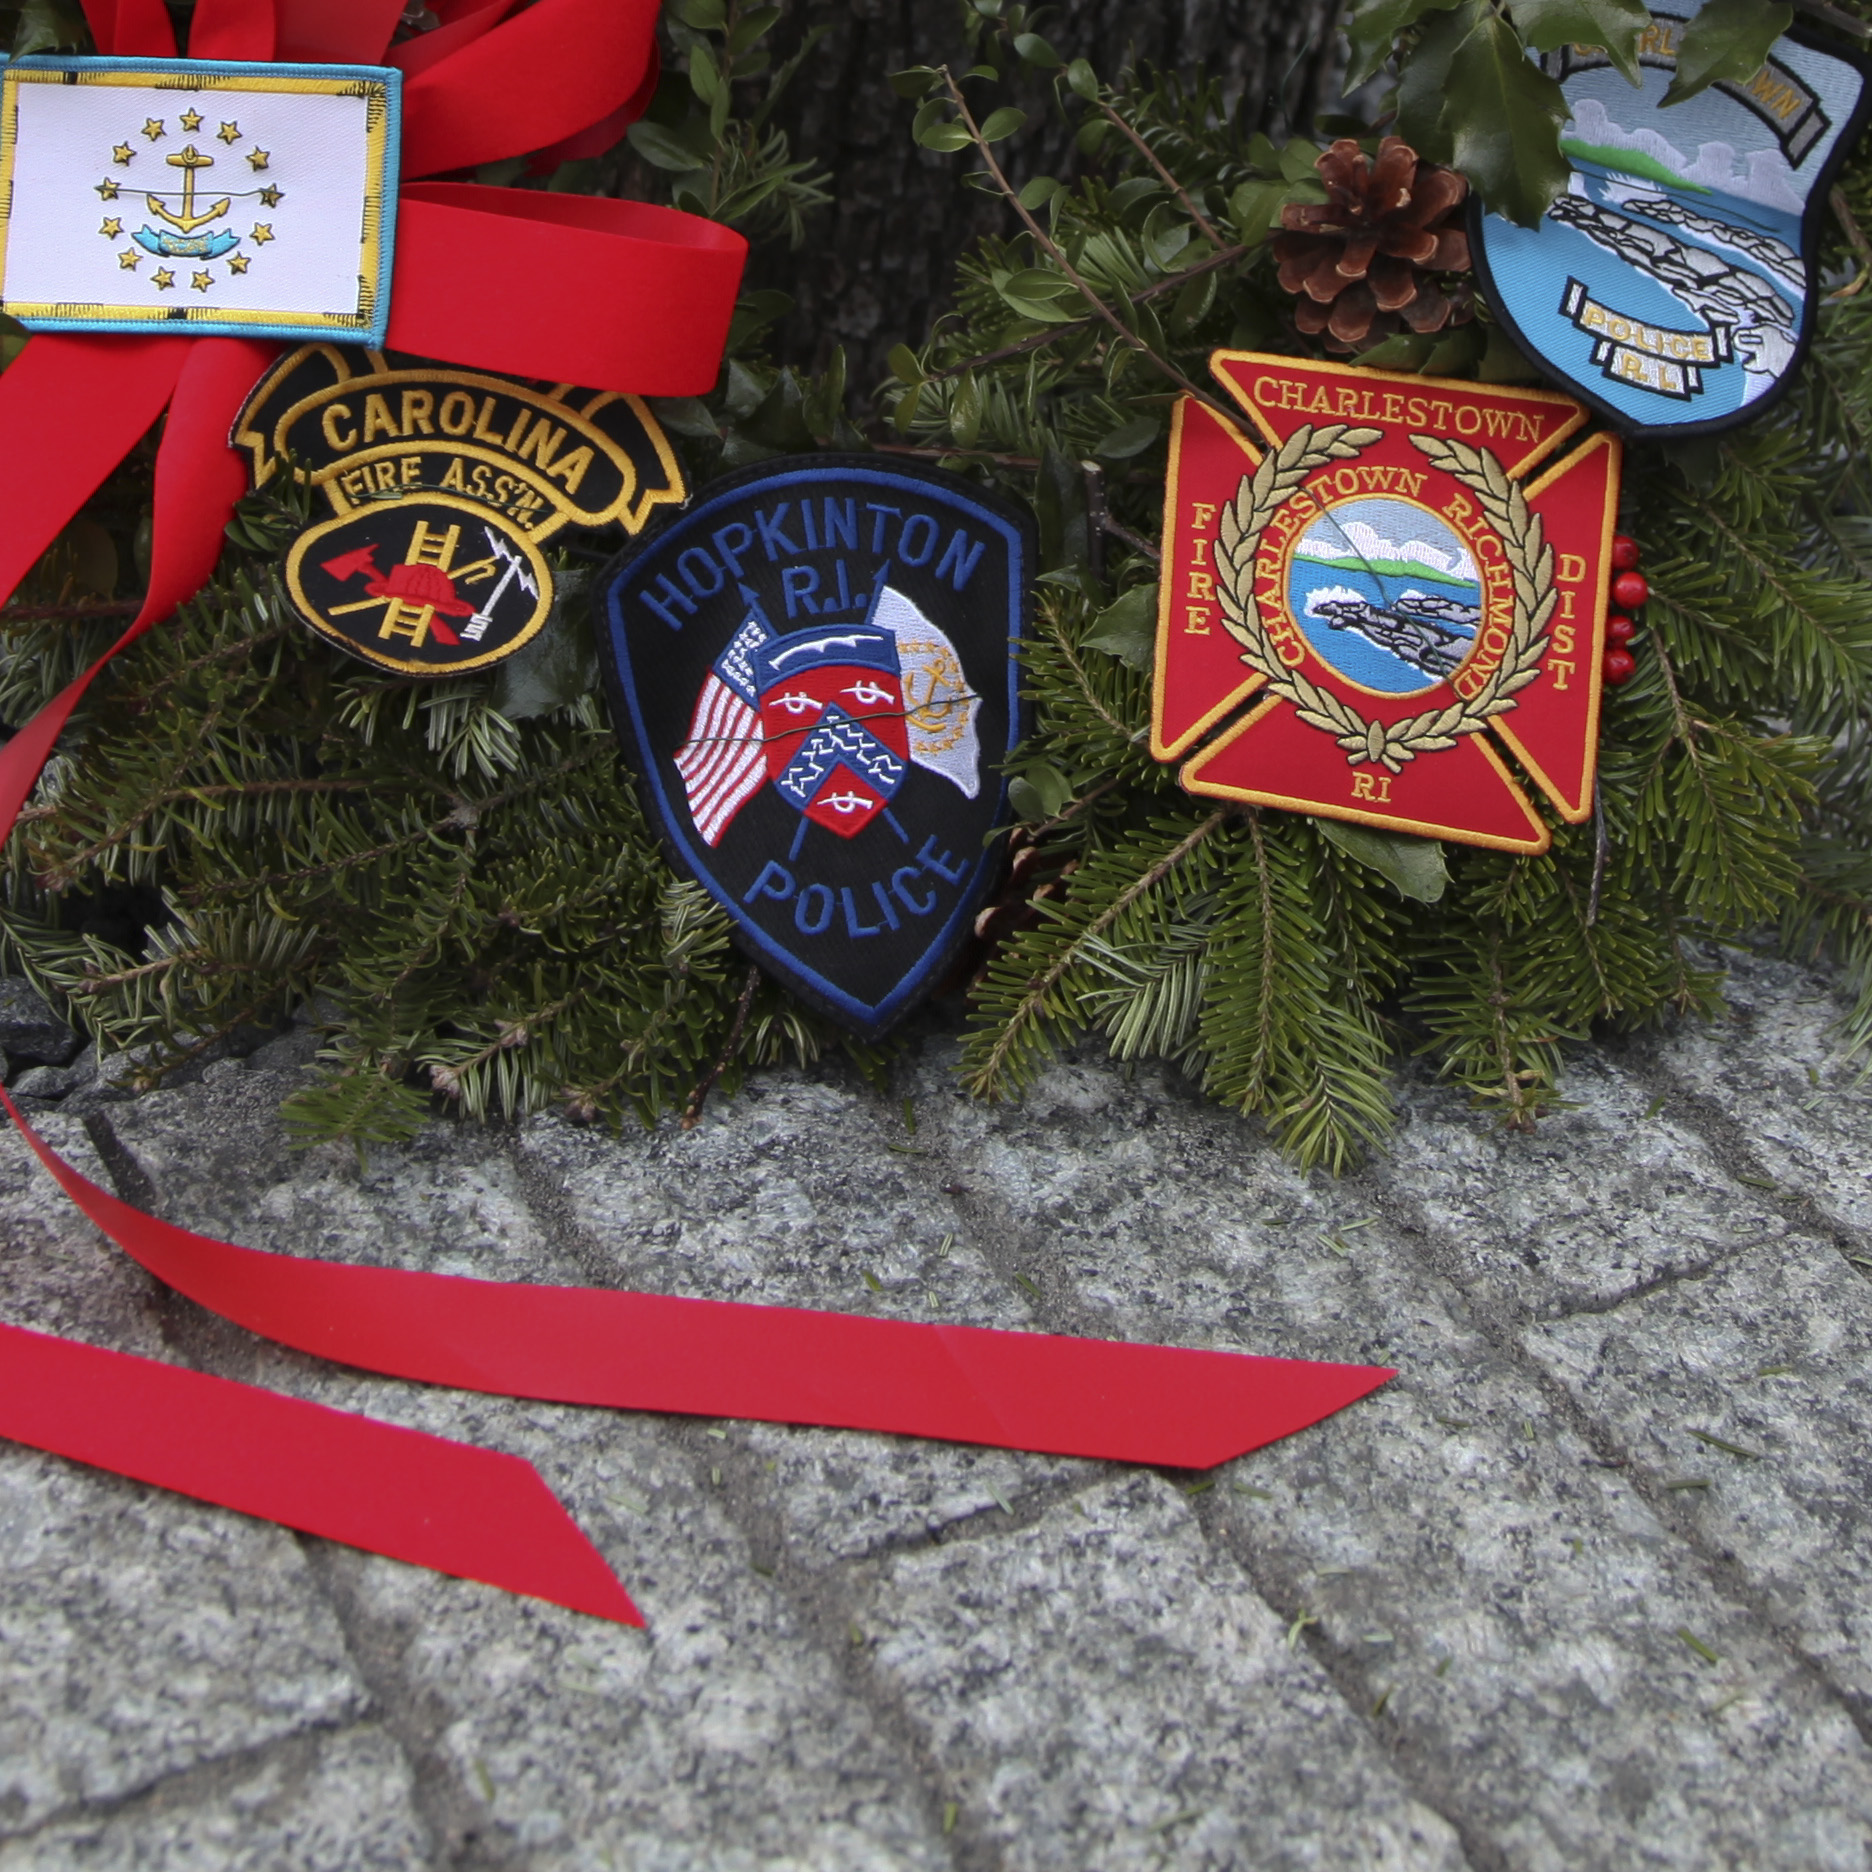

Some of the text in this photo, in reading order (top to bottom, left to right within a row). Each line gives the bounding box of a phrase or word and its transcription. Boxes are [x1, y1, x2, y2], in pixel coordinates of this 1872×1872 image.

[1583, 306, 1711, 360] POLICE
[322, 390, 596, 495] CAROLINA
[1253, 376, 1546, 444] CHARLESTOWN
[341, 456, 422, 505] FIRE
[639, 496, 985, 630] HOPKINTON
[781, 559, 867, 619] R.I.
[1183, 502, 1216, 636] FIRE
[1254, 466, 1509, 702] CHARLESTOWN RICHMOND
[1547, 554, 1587, 692] DIST
[1351, 771, 1392, 803] RI
[742, 835, 971, 939] POLICE
